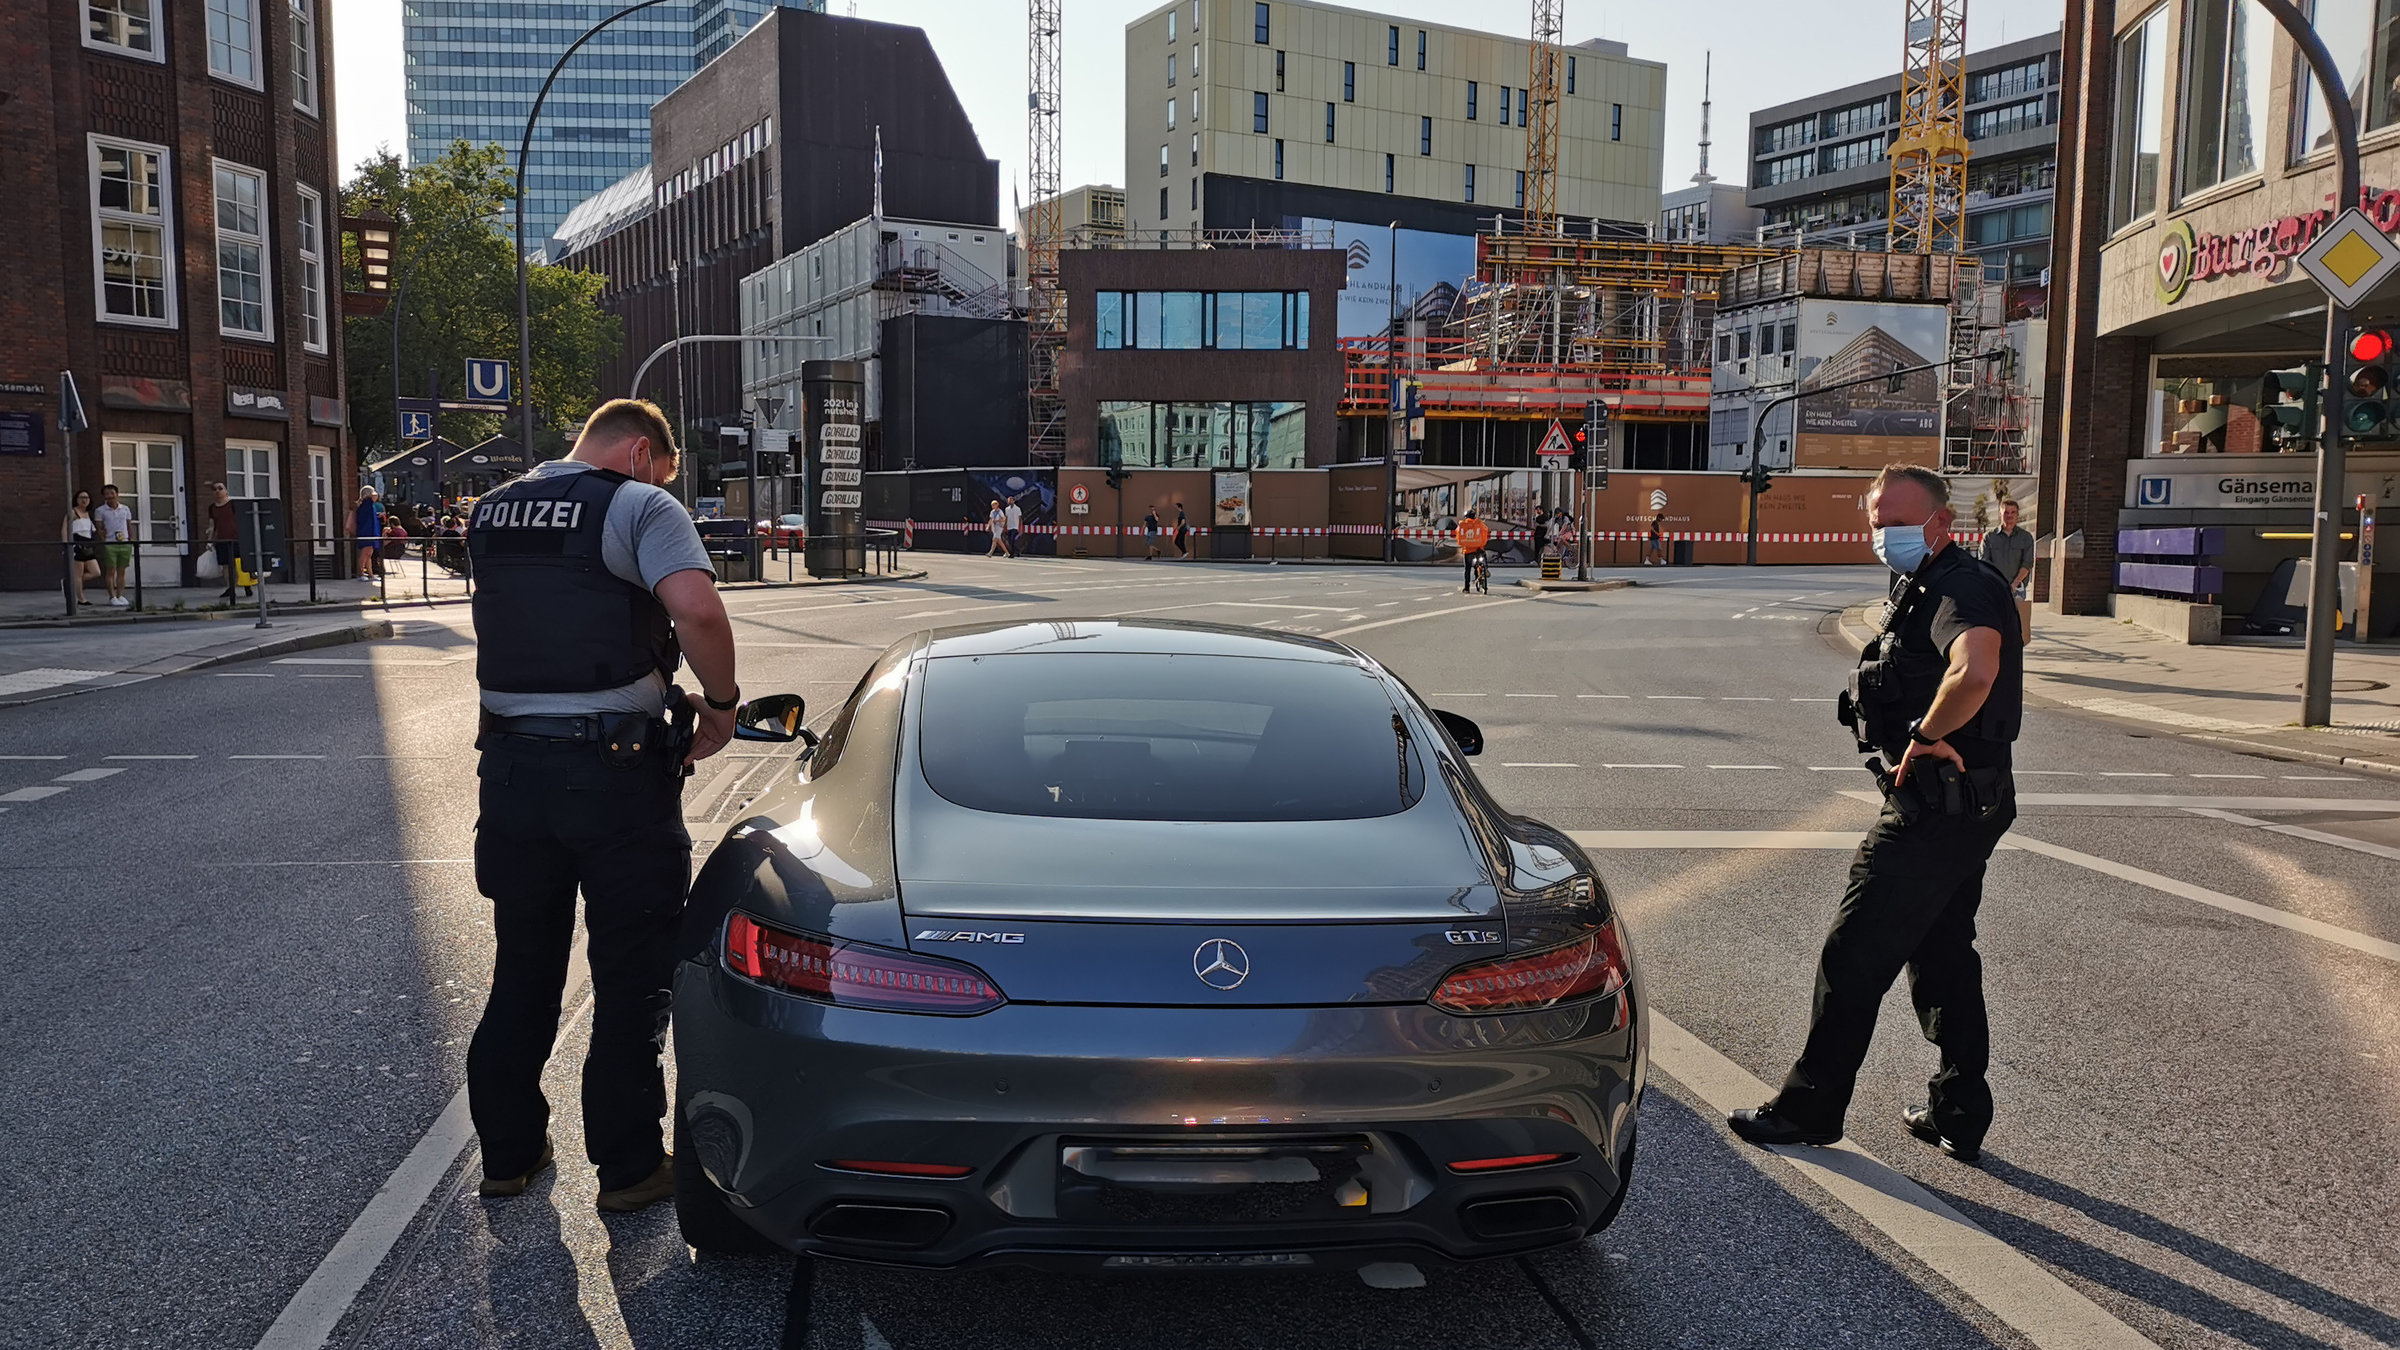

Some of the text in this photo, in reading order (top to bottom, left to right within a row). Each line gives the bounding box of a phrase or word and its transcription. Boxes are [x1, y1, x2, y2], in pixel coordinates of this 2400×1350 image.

[473, 363, 503, 396] U
[823, 398, 845, 408] 2021
[846, 399, 854, 408] in
[825, 426, 858, 438] GORILLAS
[826, 449, 858, 460] GORILLAS
[826, 471, 858, 482] GORILLAS
[2145, 480, 2167, 503] U
[2218, 478, 2317, 494] Gänsema
[826, 494, 859, 505] GORILLAS
[2235, 496, 2270, 505] Eingang
[475, 501, 582, 529] POLIZEI
